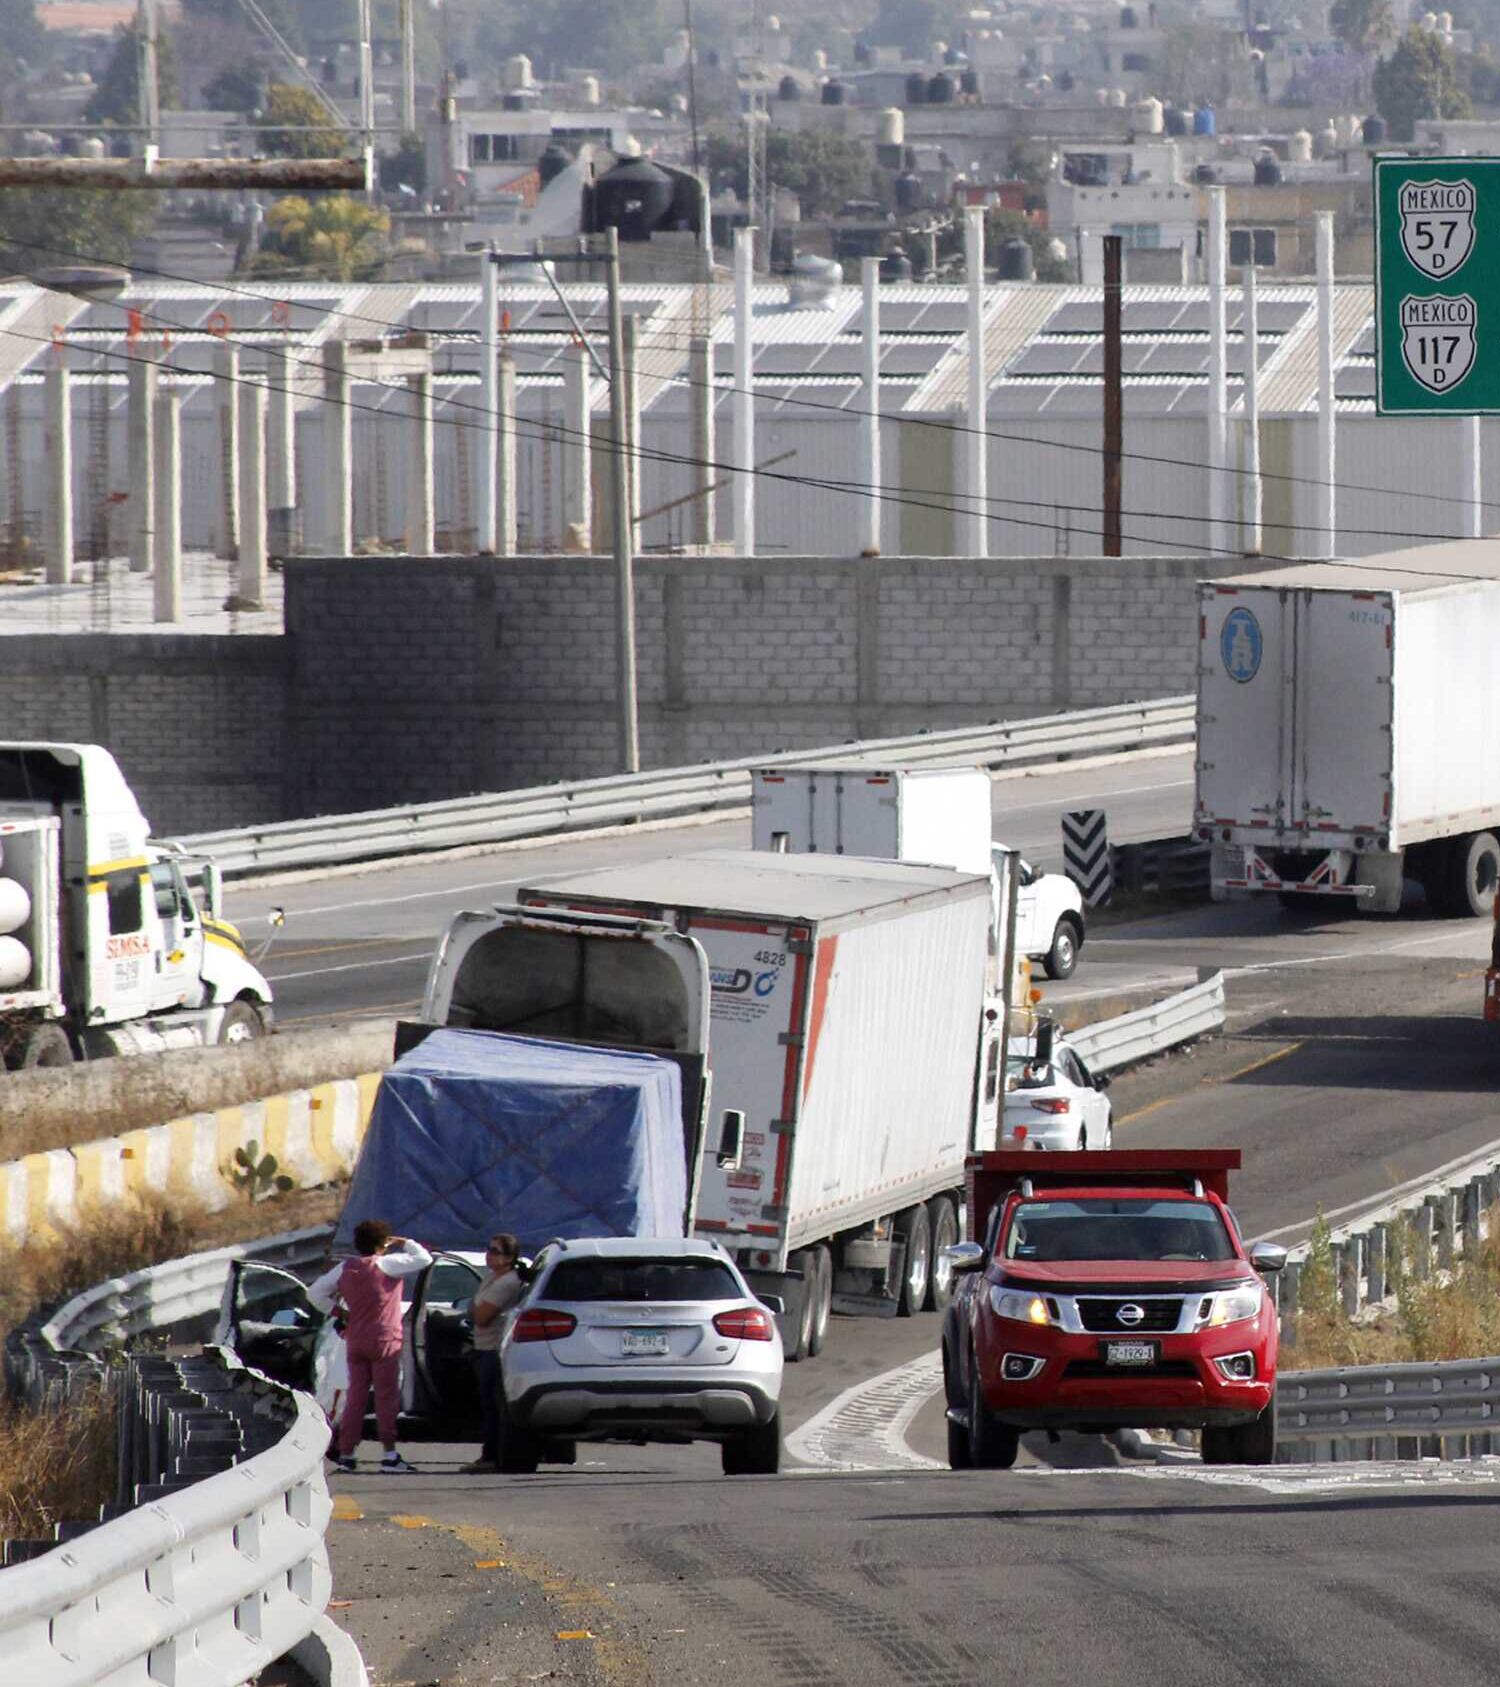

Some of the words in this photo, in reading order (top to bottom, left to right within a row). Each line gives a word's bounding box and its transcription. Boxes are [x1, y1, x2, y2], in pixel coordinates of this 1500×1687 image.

[1408, 188, 1467, 211] MEXICO
[1416, 220, 1459, 250] 57
[1432, 254, 1446, 270] D
[1408, 302, 1469, 323] MEXICO
[1417, 336, 1461, 366] 117
[1433, 369, 1446, 386] D
[753, 950, 786, 967] 4828
